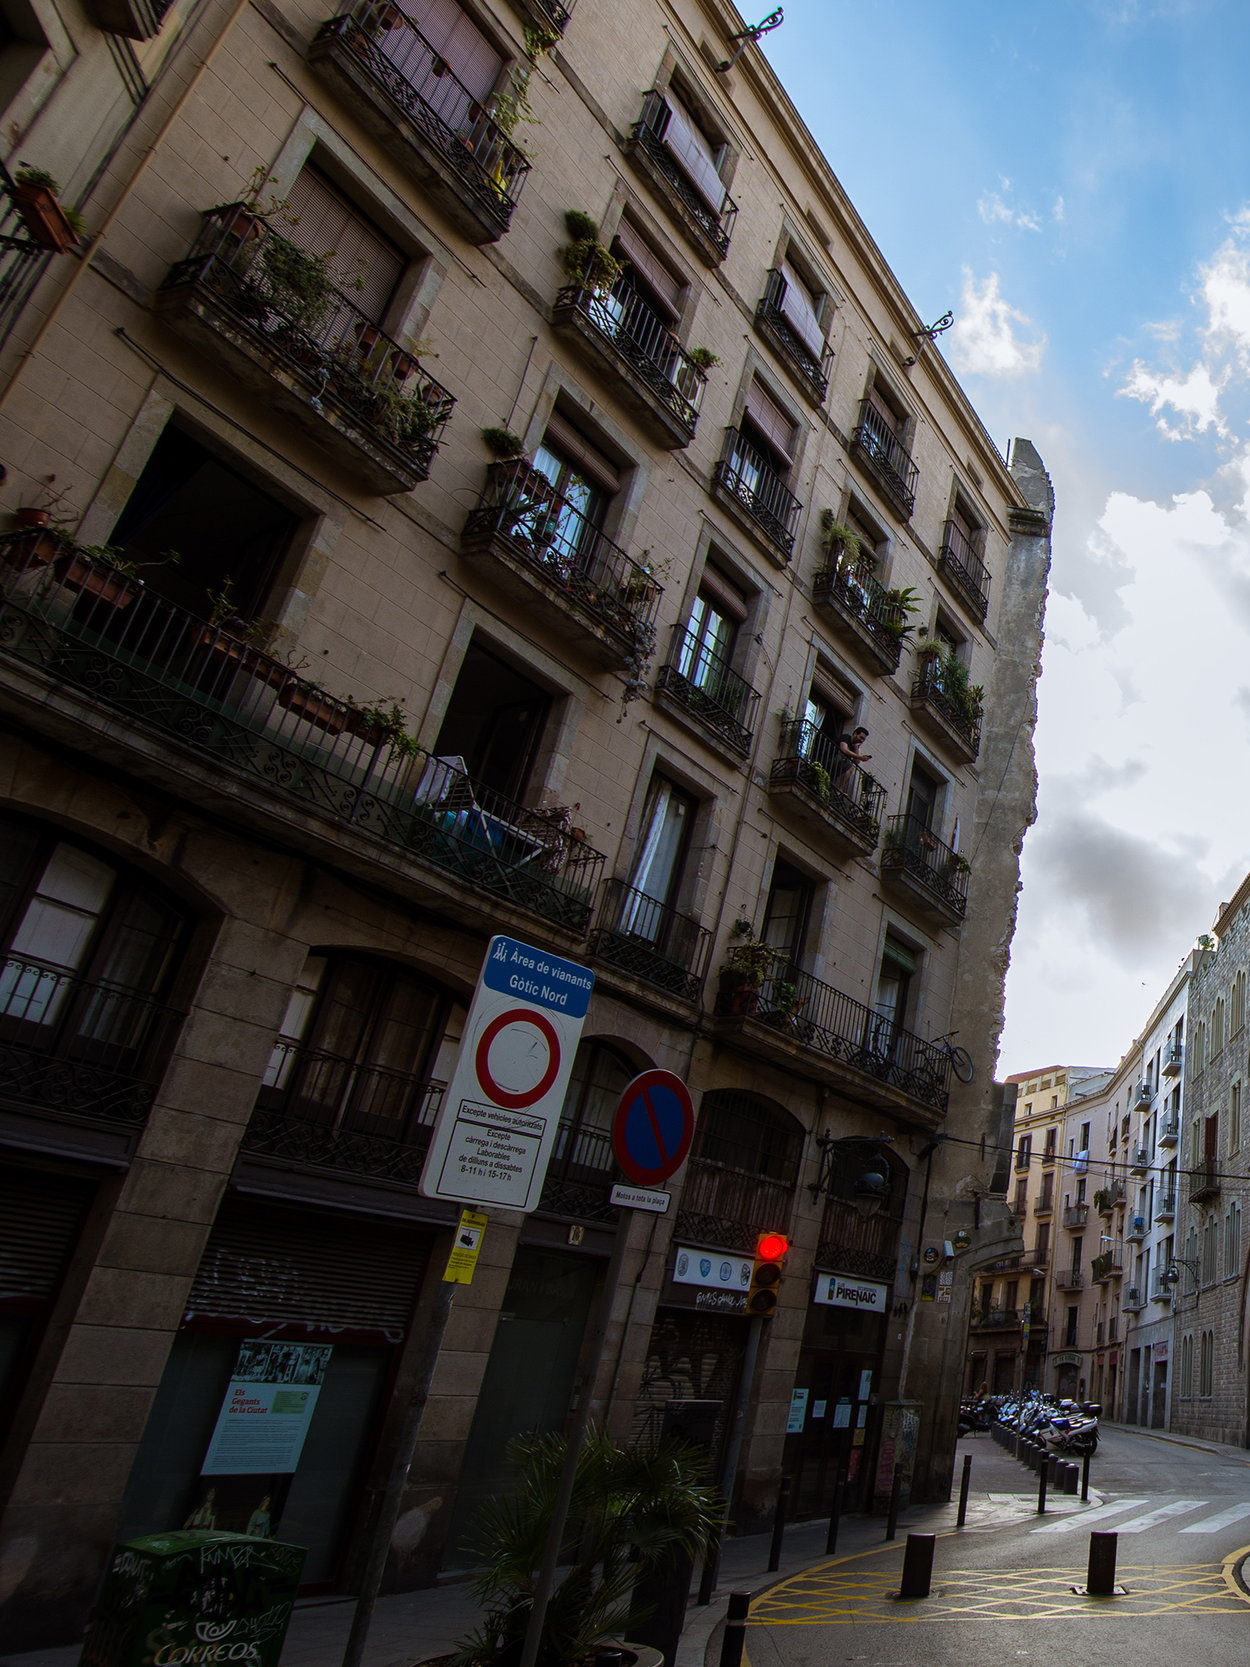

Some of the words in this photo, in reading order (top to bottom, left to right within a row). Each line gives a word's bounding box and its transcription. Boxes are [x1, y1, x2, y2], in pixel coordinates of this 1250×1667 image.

[510, 947, 535, 969] Àrea
[536, 961, 550, 974] de
[551, 967, 592, 990] vianants
[509, 974, 540, 996] Gòtic
[540, 985, 568, 1006] Nord
[461, 1105, 487, 1119] Excepte
[486, 1129, 511, 1141] Excepte
[476, 1148, 511, 1161] Laborables
[458, 1154, 467, 1163] de
[468, 1156, 489, 1168] dilluns
[493, 1161, 523, 1173] dissabtes
[488, 1170, 508, 1180] 15-17
[836, 1287, 877, 1306] PIRENAIC
[234, 1388, 246, 1397] Els
[231, 1397, 261, 1406] Gegants
[228, 1405, 238, 1414] de
[238, 1406, 246, 1414] la
[246, 1406, 268, 1414] Ciutat
[154, 1641, 261, 1667] CORREOS
